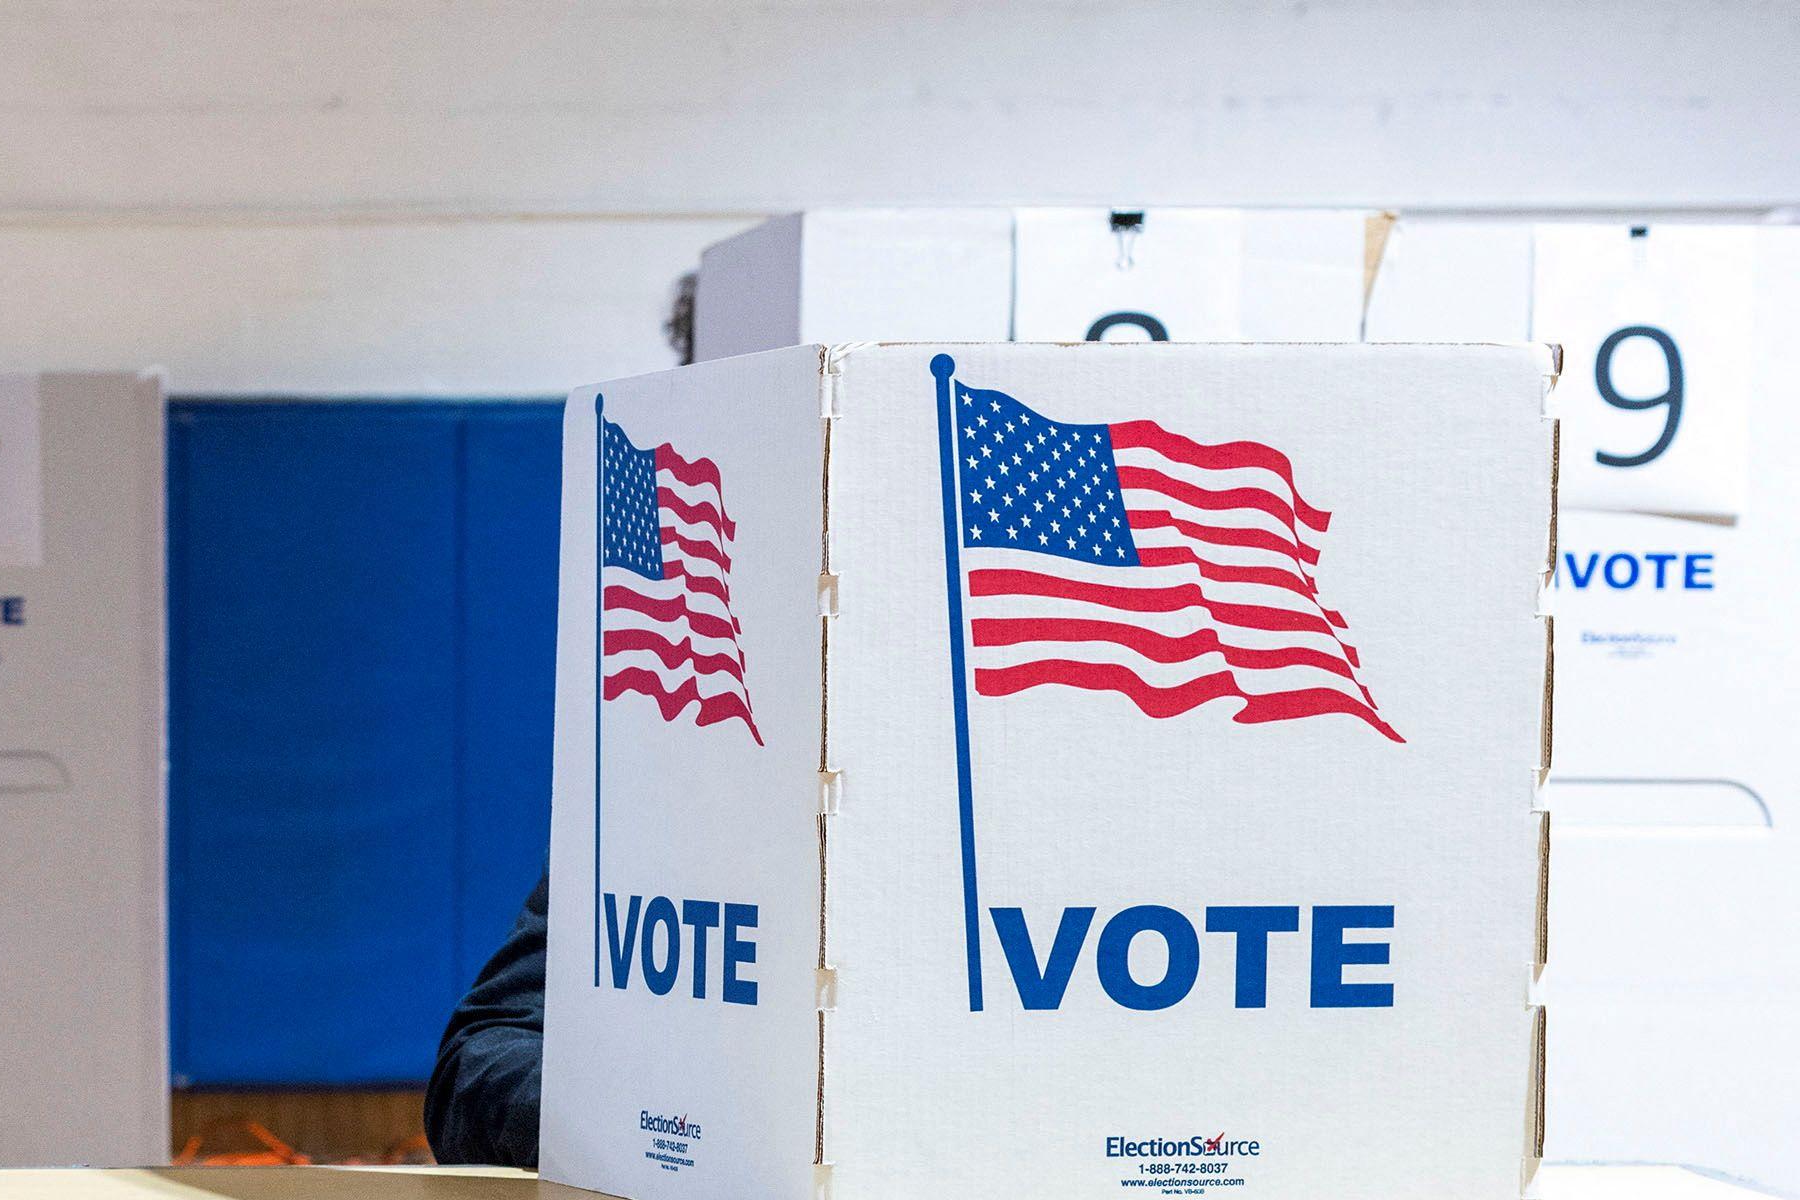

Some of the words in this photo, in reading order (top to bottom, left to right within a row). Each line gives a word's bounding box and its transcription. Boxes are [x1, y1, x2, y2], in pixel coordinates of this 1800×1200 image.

[1595, 325, 1685, 468] 9
[1565, 553, 1714, 589] VOTE
[603, 893, 758, 1005] VOTE
[989, 905, 1394, 1011] VOTE
[640, 1110, 701, 1140] ElectionSource
[1106, 1132, 1260, 1158] ElectionSource
[1121, 1177, 1244, 1187] www.electionsource.com
[1138, 1163, 1228, 1174] 1-888-742-8037
